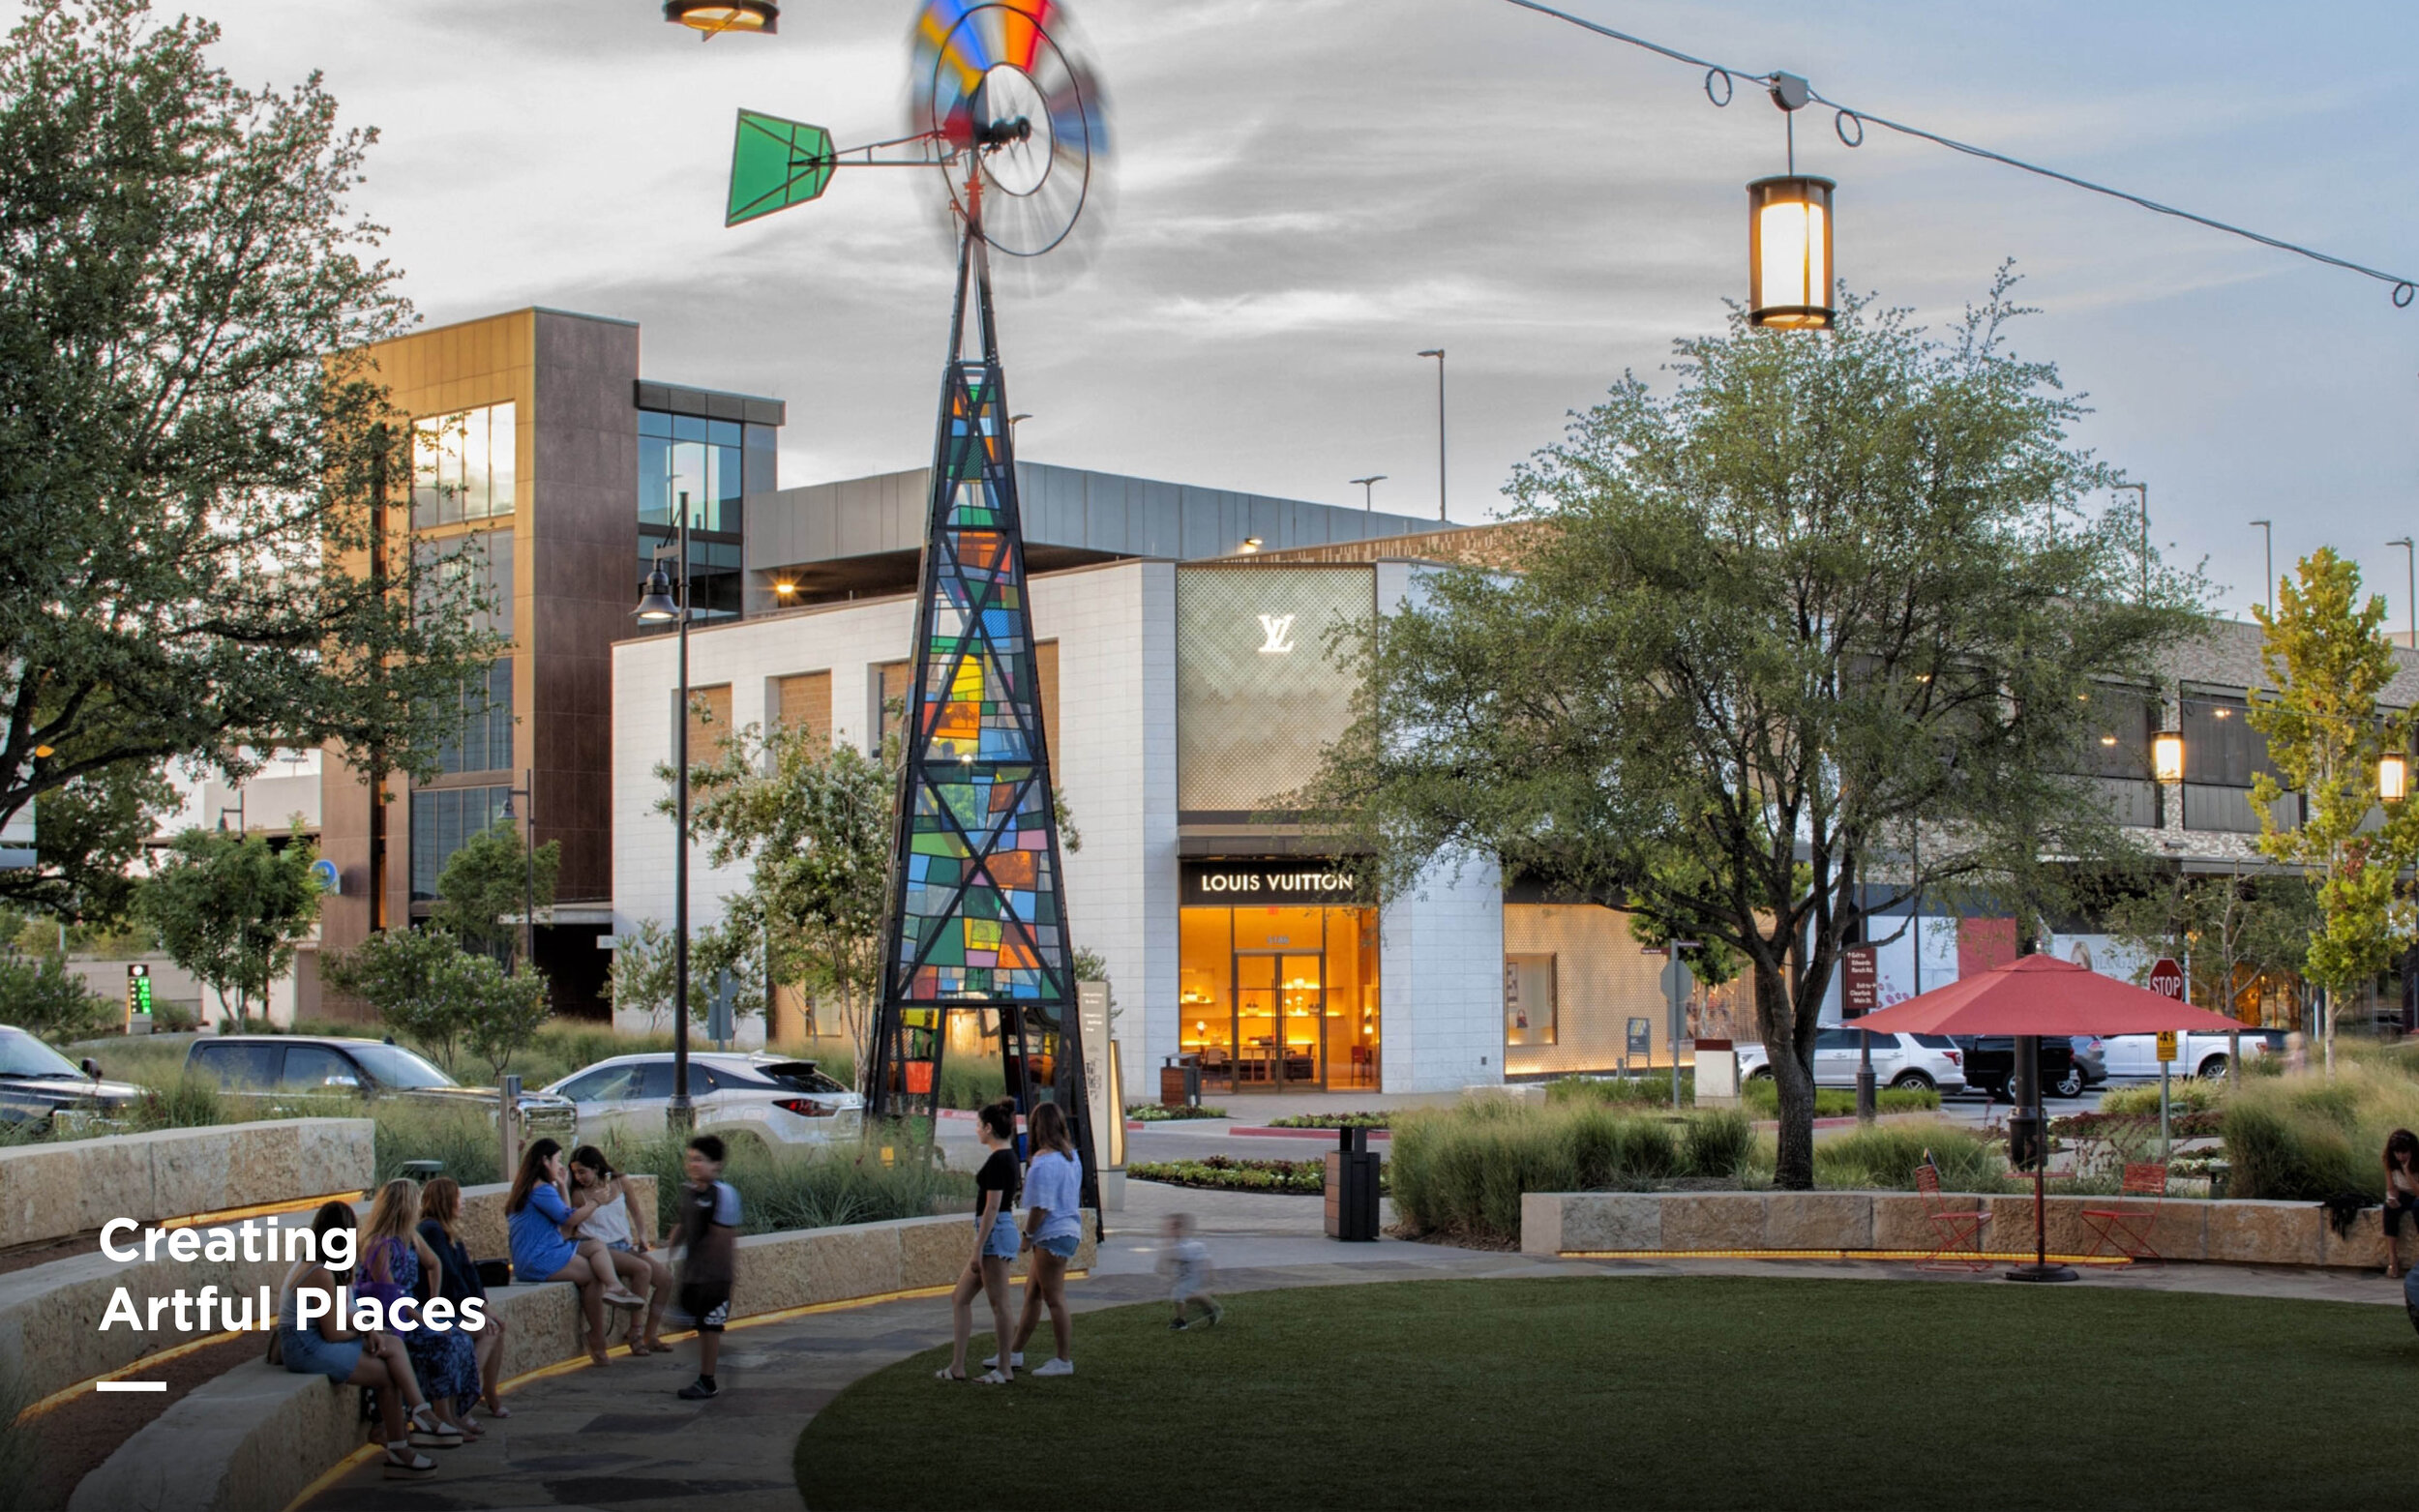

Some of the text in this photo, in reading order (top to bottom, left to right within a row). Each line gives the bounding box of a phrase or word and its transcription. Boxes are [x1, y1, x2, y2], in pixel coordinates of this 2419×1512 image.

[1202, 874, 1353, 891] LOUIS VUITTON
[2152, 976, 2181, 996] STOP
